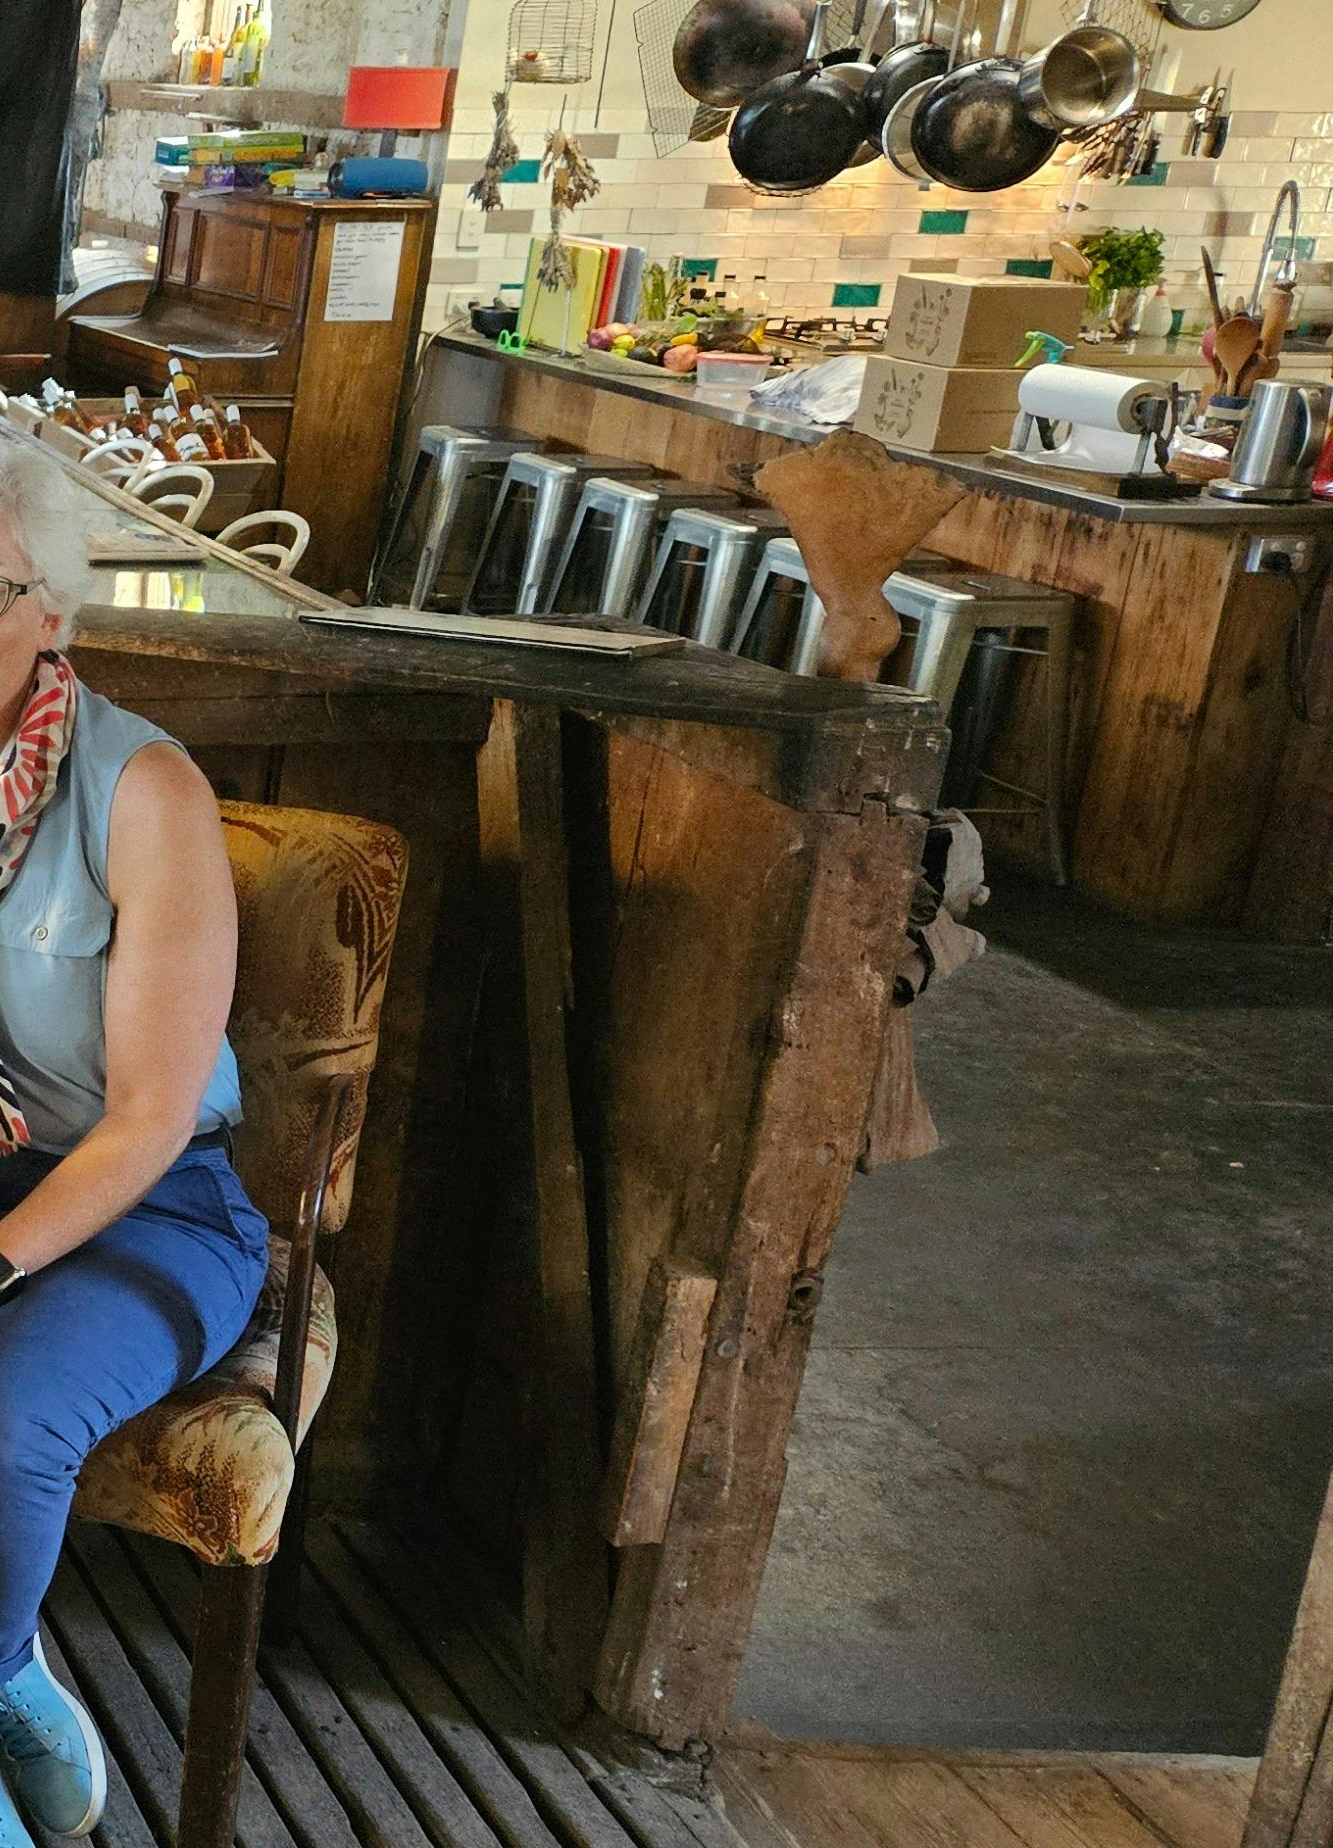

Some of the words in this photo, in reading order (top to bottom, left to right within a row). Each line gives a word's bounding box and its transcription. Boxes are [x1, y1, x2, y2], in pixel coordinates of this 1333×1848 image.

[1181, 3, 1194, 19] 7
[1198, 9, 1211, 25] 6
[1220, 4, 1234, 18] 5
